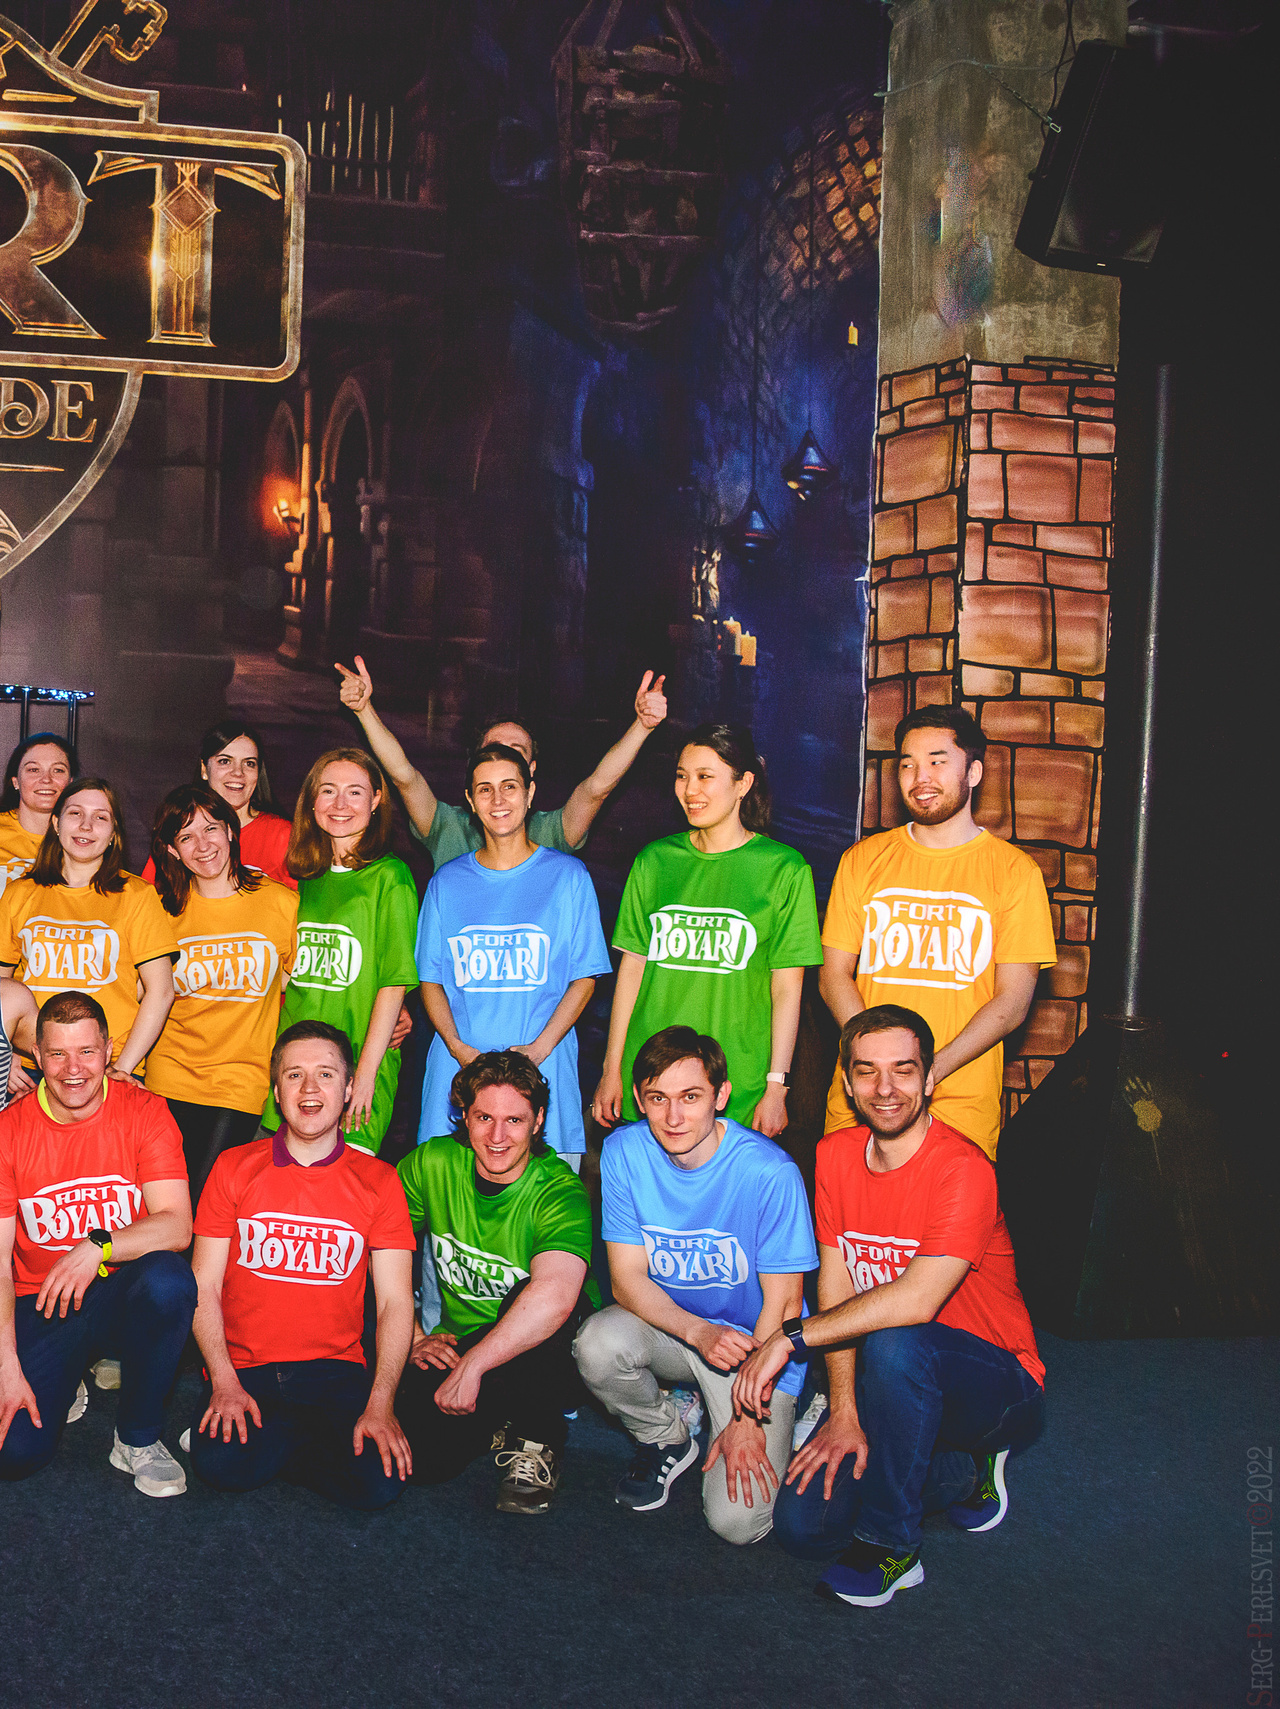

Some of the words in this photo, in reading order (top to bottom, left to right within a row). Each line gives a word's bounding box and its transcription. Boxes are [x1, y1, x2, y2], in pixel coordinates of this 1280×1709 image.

[672, 913, 727, 928] FORT
[892, 900, 956, 922] FORT
[33, 925, 90, 941] FORT
[300, 931, 337, 945] FORT
[473, 932, 524, 948] FORT
[647, 911, 757, 971] BOYARD
[858, 900, 993, 983] BOYARD
[189, 941, 246, 959] FORT
[447, 931, 551, 987] BOYARD
[55, 1186, 111, 1206] FORT
[268, 1222, 333, 1241] FORT
[236, 1217, 364, 1280] BOYARD
[655, 1235, 712, 1251] FORT
[453, 1247, 500, 1277] FORT
